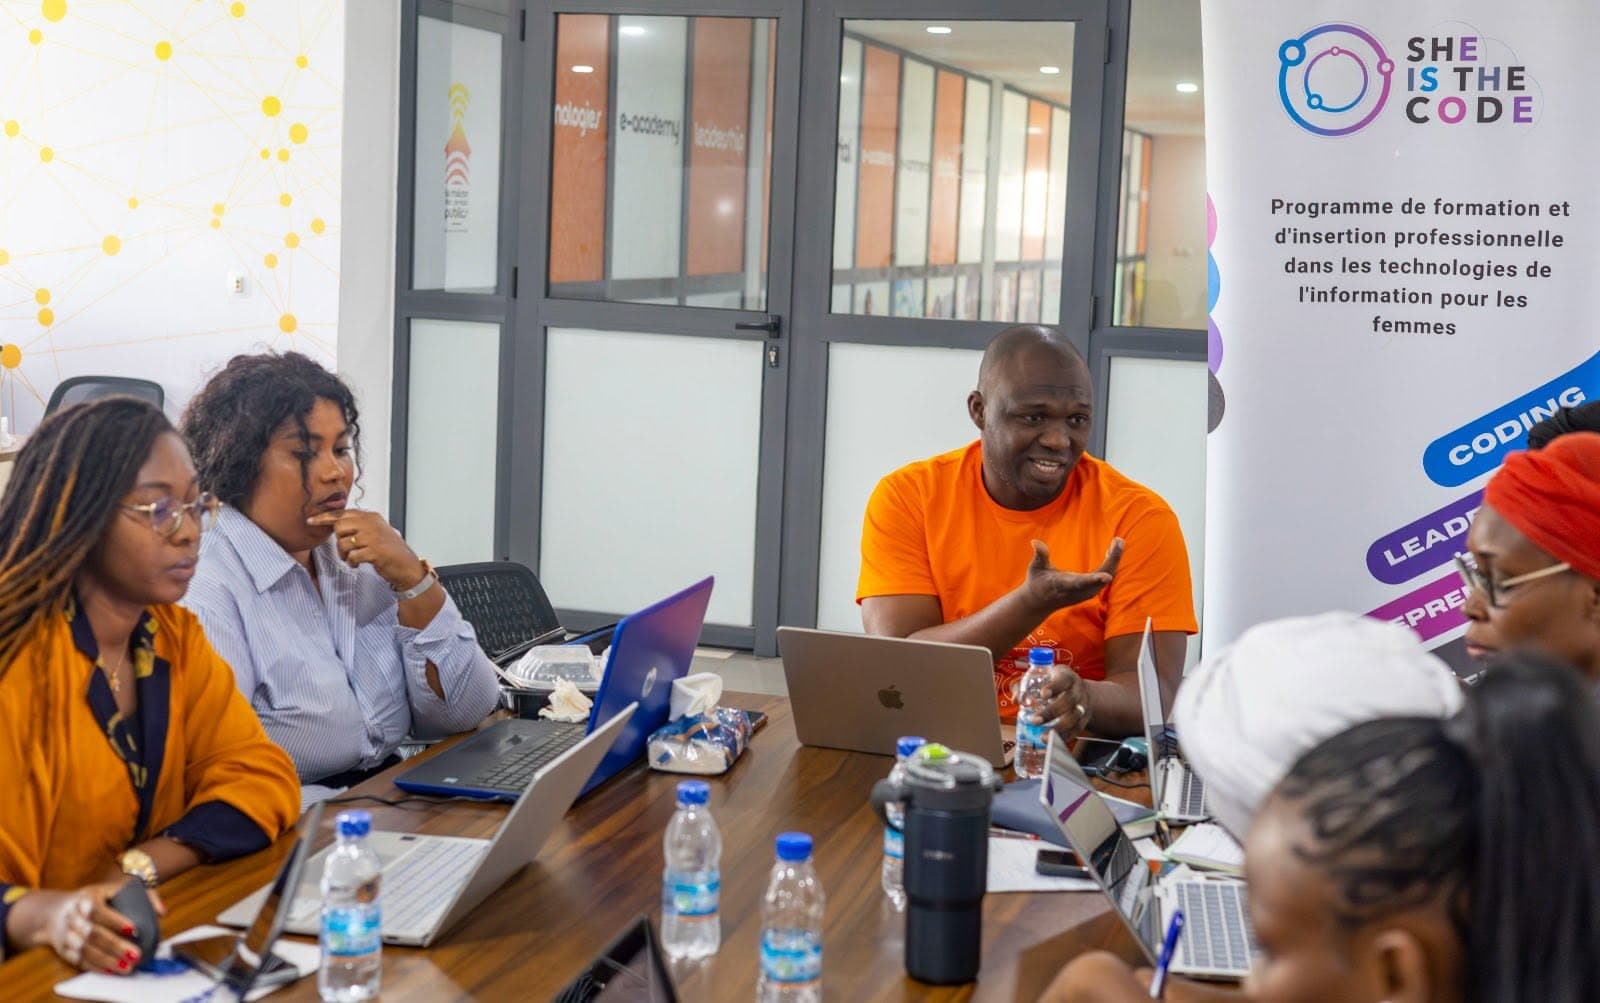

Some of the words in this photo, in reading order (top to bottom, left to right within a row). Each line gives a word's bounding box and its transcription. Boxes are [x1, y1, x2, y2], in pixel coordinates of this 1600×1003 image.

[1407, 37, 1478, 62] SHE
[1408, 66, 1438, 92] IS
[1453, 66, 1525, 91] THE
[1406, 96, 1532, 124] CODE
[619, 112, 680, 146] e-academy
[1272, 199, 1393, 219] Programme
[1401, 197, 1425, 214] de
[1434, 198, 1540, 216] formation
[1549, 201, 1570, 216] et
[1275, 228, 1385, 244] d'insertion
[1395, 228, 1564, 248] professionnelle
[1285, 257, 1333, 273] dans
[1342, 257, 1371, 273] les
[1379, 257, 1518, 280] technologies
[1526, 261, 1551, 278] de
[1299, 286, 1432, 304] l'information
[1441, 293, 1488, 309] pour
[1497, 290, 1527, 308] les
[1373, 316, 1456, 335] femmes
[1449, 386, 1586, 466] CODING
